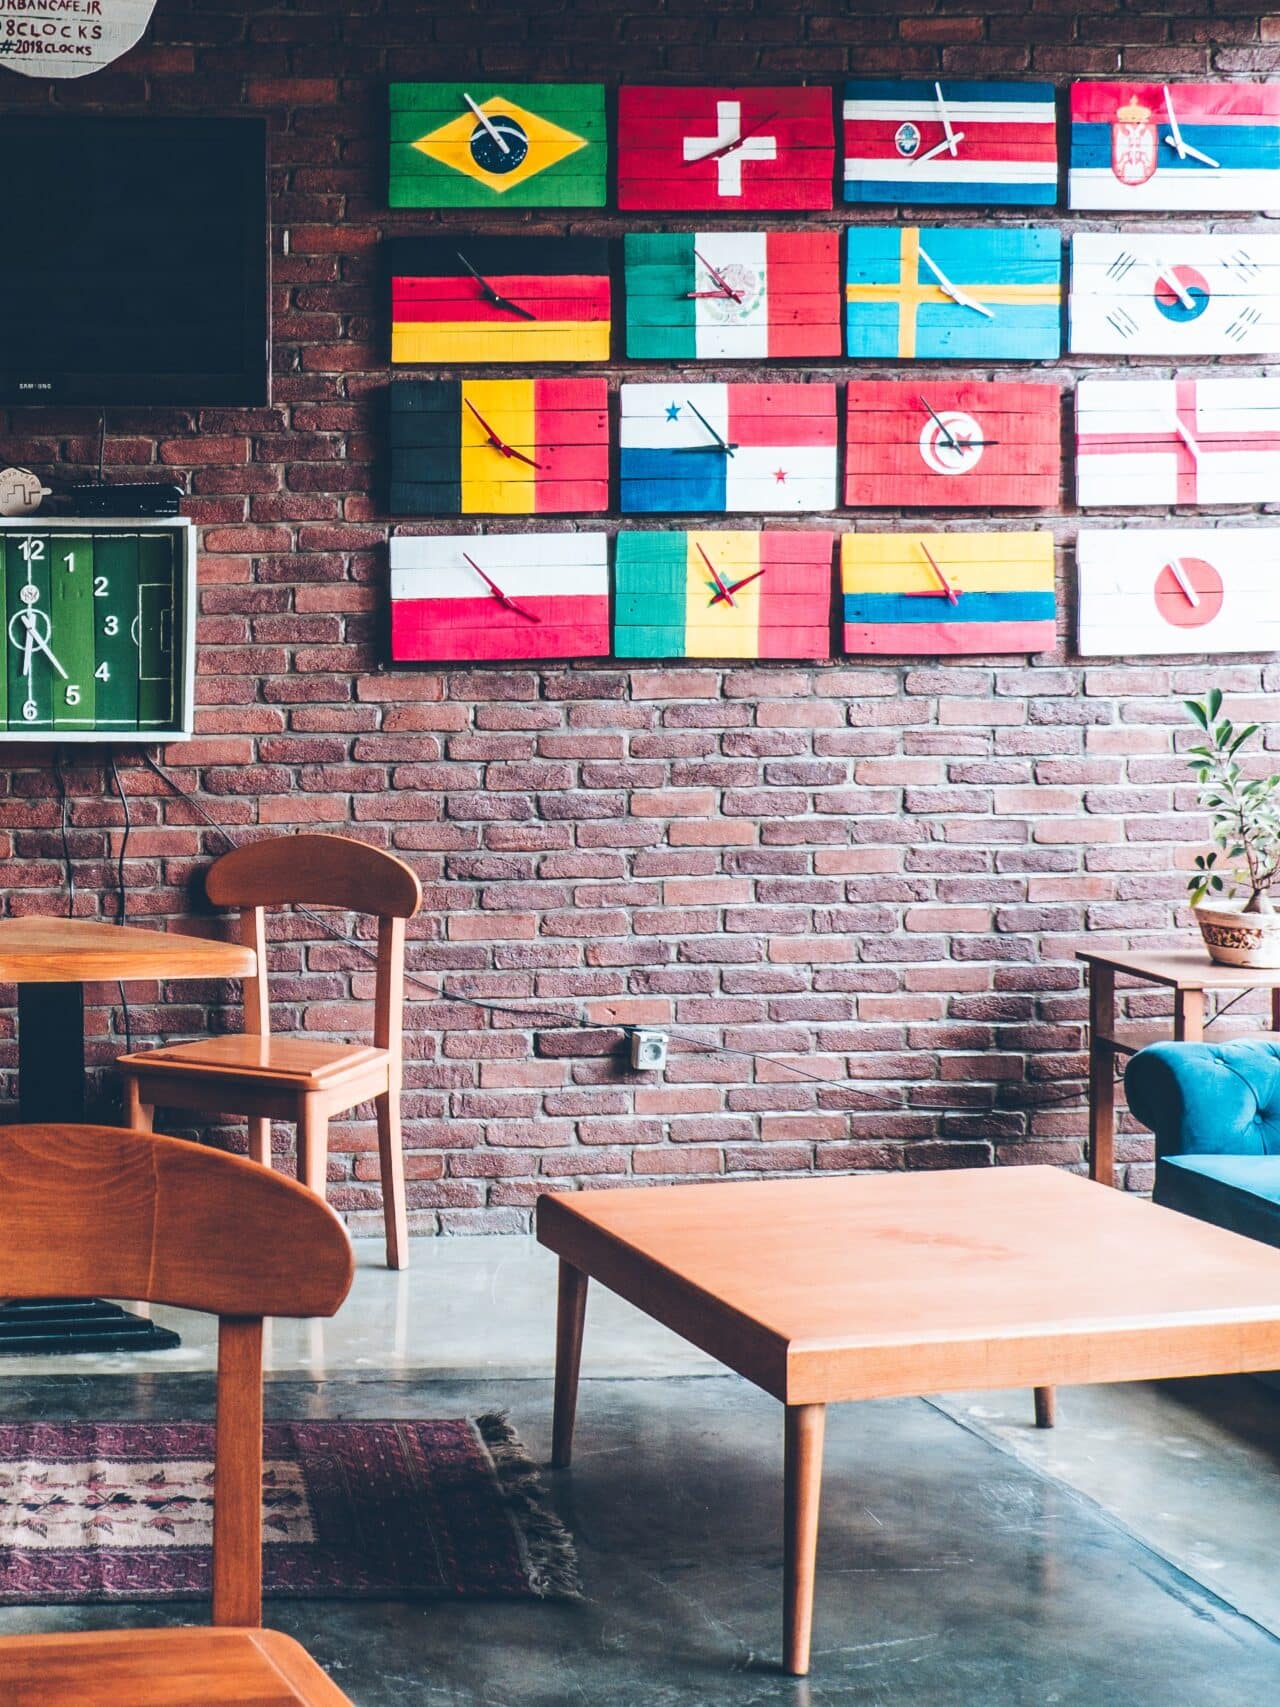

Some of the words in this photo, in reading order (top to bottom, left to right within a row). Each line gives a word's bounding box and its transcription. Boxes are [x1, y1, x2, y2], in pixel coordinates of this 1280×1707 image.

[6, 19, 102, 40] 8CLOCKS
[18, 540, 45, 560] 12
[63, 552, 75, 573] 1
[94, 576, 108, 597] 2
[104, 615, 118, 636] 3
[94, 661, 111, 682] 4
[66, 684, 81, 706] 5
[23, 700, 38, 721] 6
